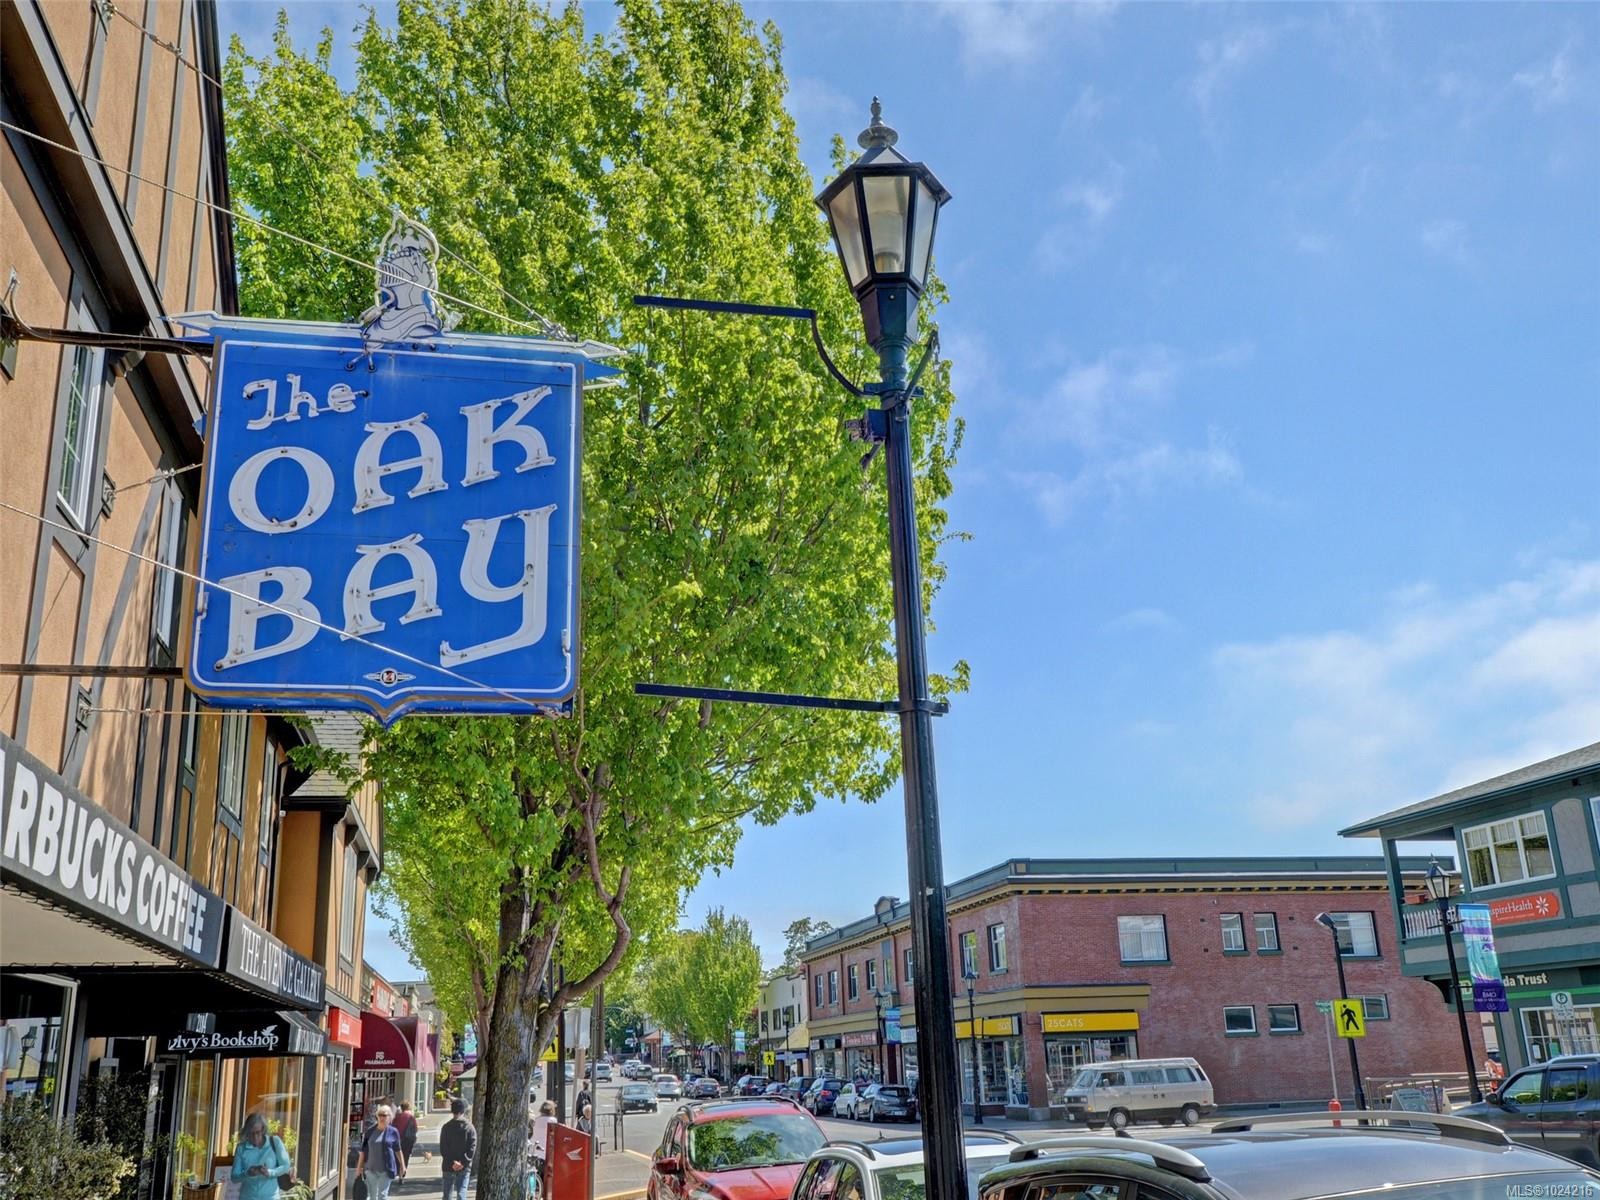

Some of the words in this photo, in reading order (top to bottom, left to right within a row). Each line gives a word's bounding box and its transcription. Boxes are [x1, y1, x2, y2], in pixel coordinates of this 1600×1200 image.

[242, 374, 369, 431] The
[228, 386, 556, 534] OAK
[214, 504, 558, 671] BAY
[0, 749, 137, 915] RBUCKS
[136, 854, 207, 954] COFFEE
[1491, 899, 1533, 916] spireHealth
[240, 923, 262, 978] THE
[260, 939, 295, 993] AVENUE
[293, 959, 323, 1003] GALLERY
[1519, 972, 1548, 986] Trust
[168, 1034, 209, 1054] Ivy's
[210, 1029, 279, 1051] Bookshop
